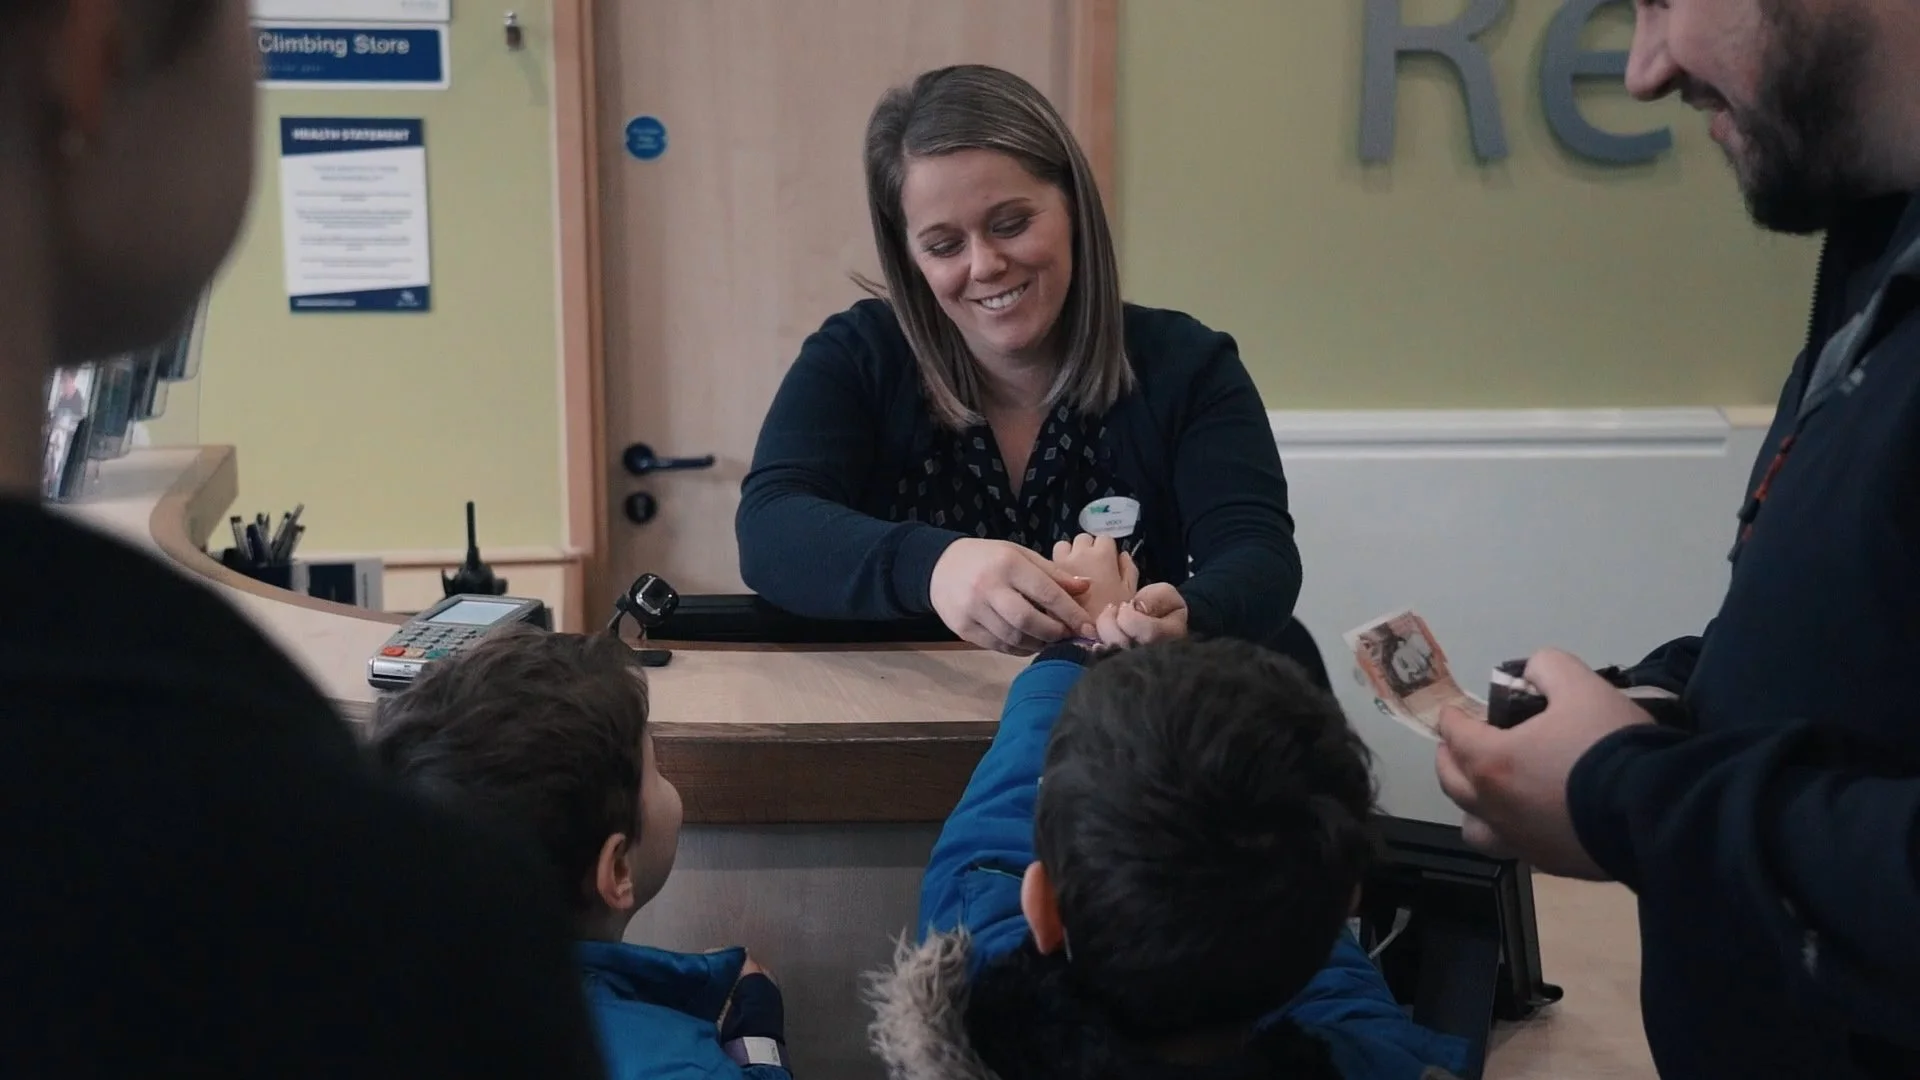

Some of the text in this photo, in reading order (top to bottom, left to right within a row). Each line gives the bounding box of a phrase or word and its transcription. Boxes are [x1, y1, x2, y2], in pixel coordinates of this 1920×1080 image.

[258, 32, 410, 57] Climbing Store
[1359, 0, 1672, 164] Re
[292, 127, 410, 141] HEALTH STATEMENT
